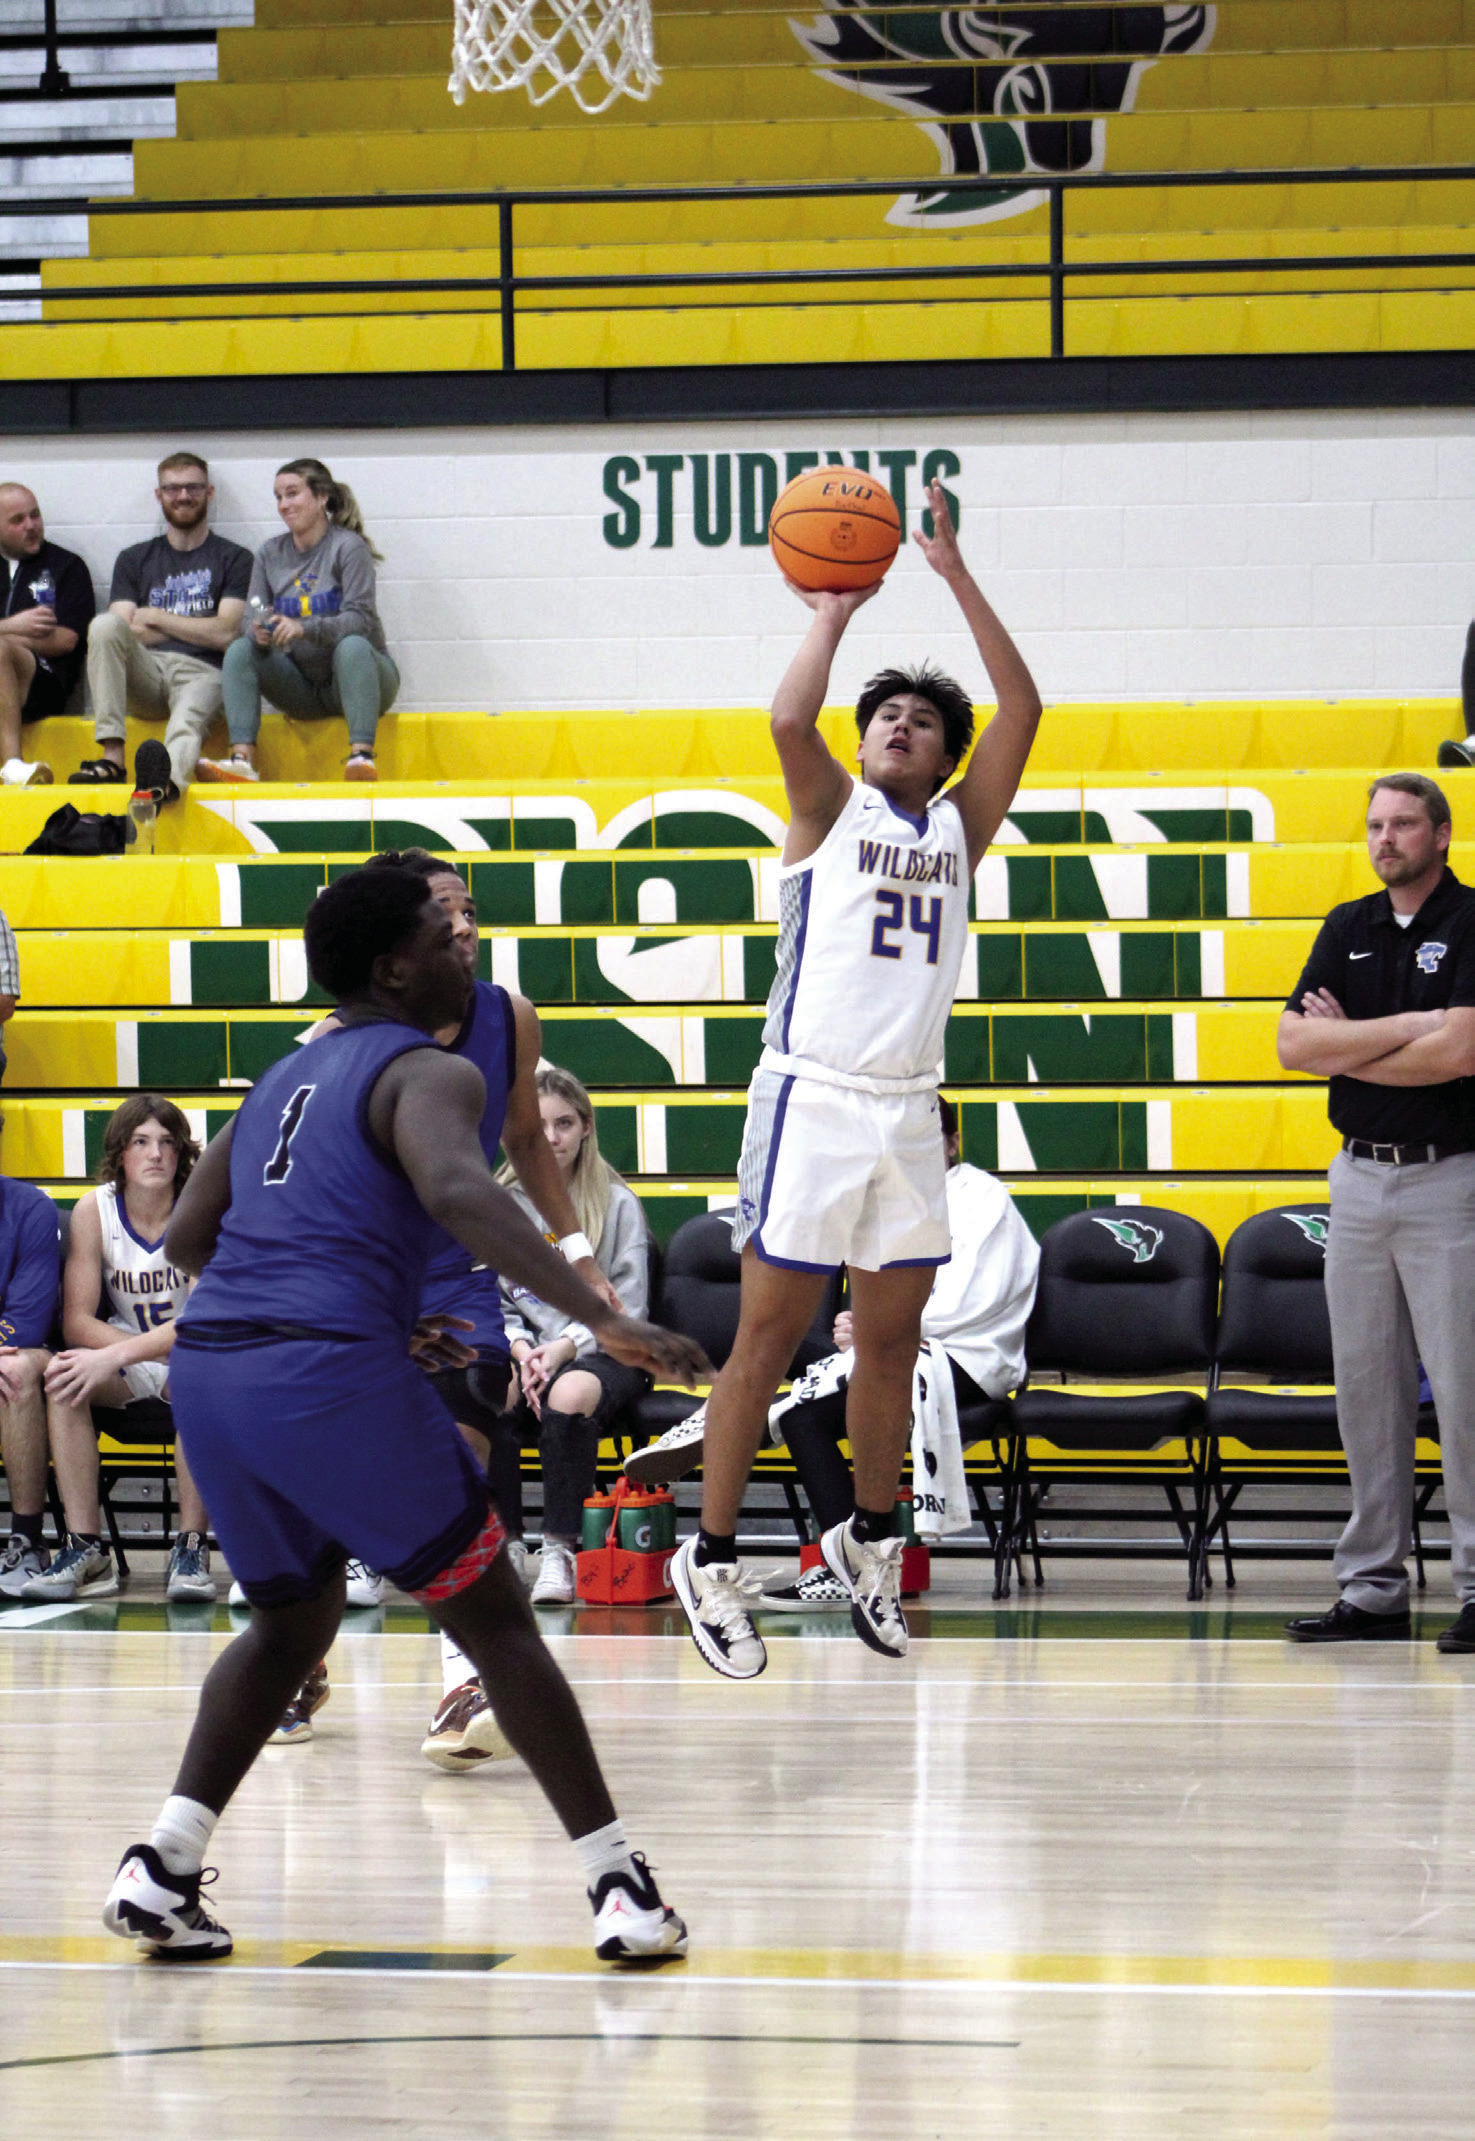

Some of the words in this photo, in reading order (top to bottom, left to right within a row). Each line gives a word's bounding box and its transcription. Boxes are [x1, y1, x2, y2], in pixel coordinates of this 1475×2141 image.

[602, 449, 961, 549] STUDTS
[870, 888, 943, 966] 24
[263, 1084, 316, 1186] 1
[133, 1301, 174, 1334] 15
